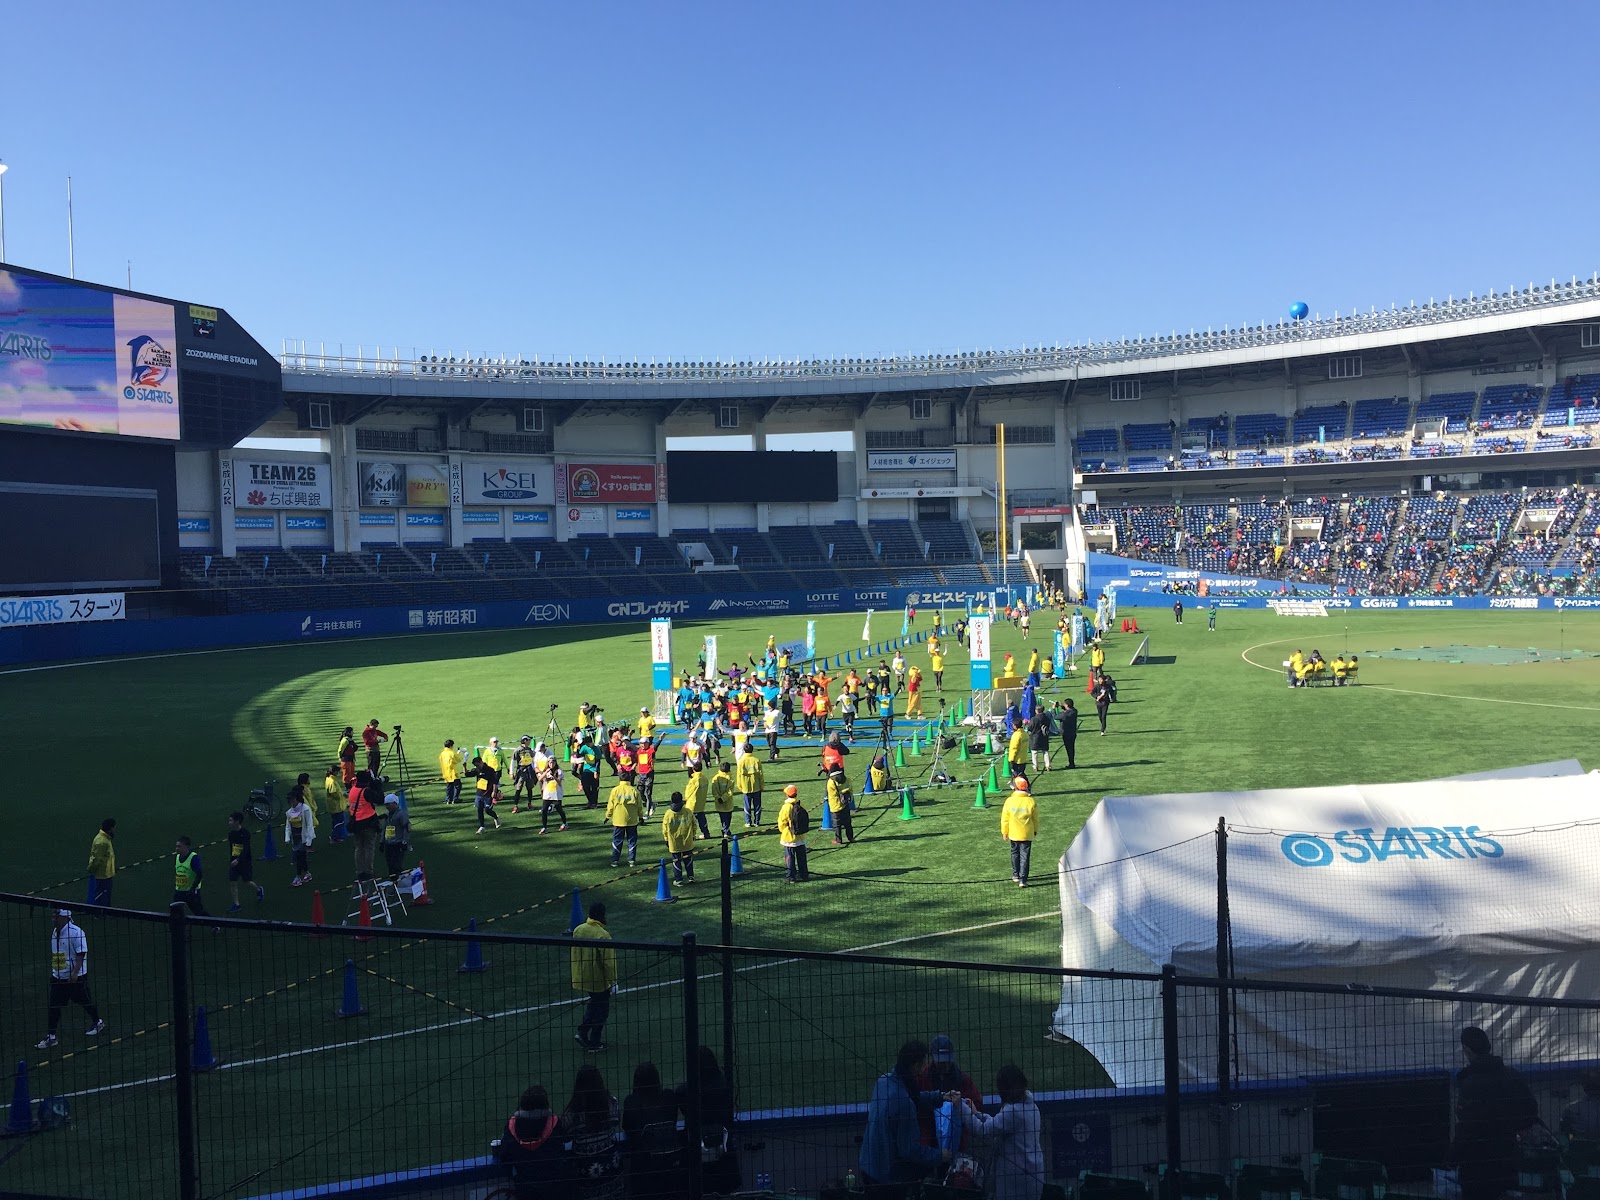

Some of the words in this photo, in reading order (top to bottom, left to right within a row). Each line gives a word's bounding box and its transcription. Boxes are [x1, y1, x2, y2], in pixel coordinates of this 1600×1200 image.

[185, 348, 230, 362] ZOZOMARINE
[229, 355, 258, 366] STADIUM
[136, 388, 173, 405] STARTS
[221, 460, 232, 496] 京成バス
[249, 464, 296, 481] TEAM
[297, 467, 316, 481] 26
[451, 463, 460, 495] 京成バス
[365, 473, 403, 492] Asahi
[601, 482, 652, 492] くすりの福太郎
[269, 491, 321, 507] ちば興銀
[497, 490, 523, 498] GROUP
[729, 599, 790, 608] INNOVATION
[806, 593, 839, 602] LOTTE
[855, 591, 888, 600] LOTTE
[0, 600, 64, 623] STARTS
[69, 598, 123, 618] スターツ
[607, 600, 690, 617] CNプレイガイド
[315, 619, 362, 632] 三井住友銀行
[426, 609, 477, 626] 新昭和
[976, 630, 984, 658] FINISH
[1334, 825, 1505, 864] STARTS
